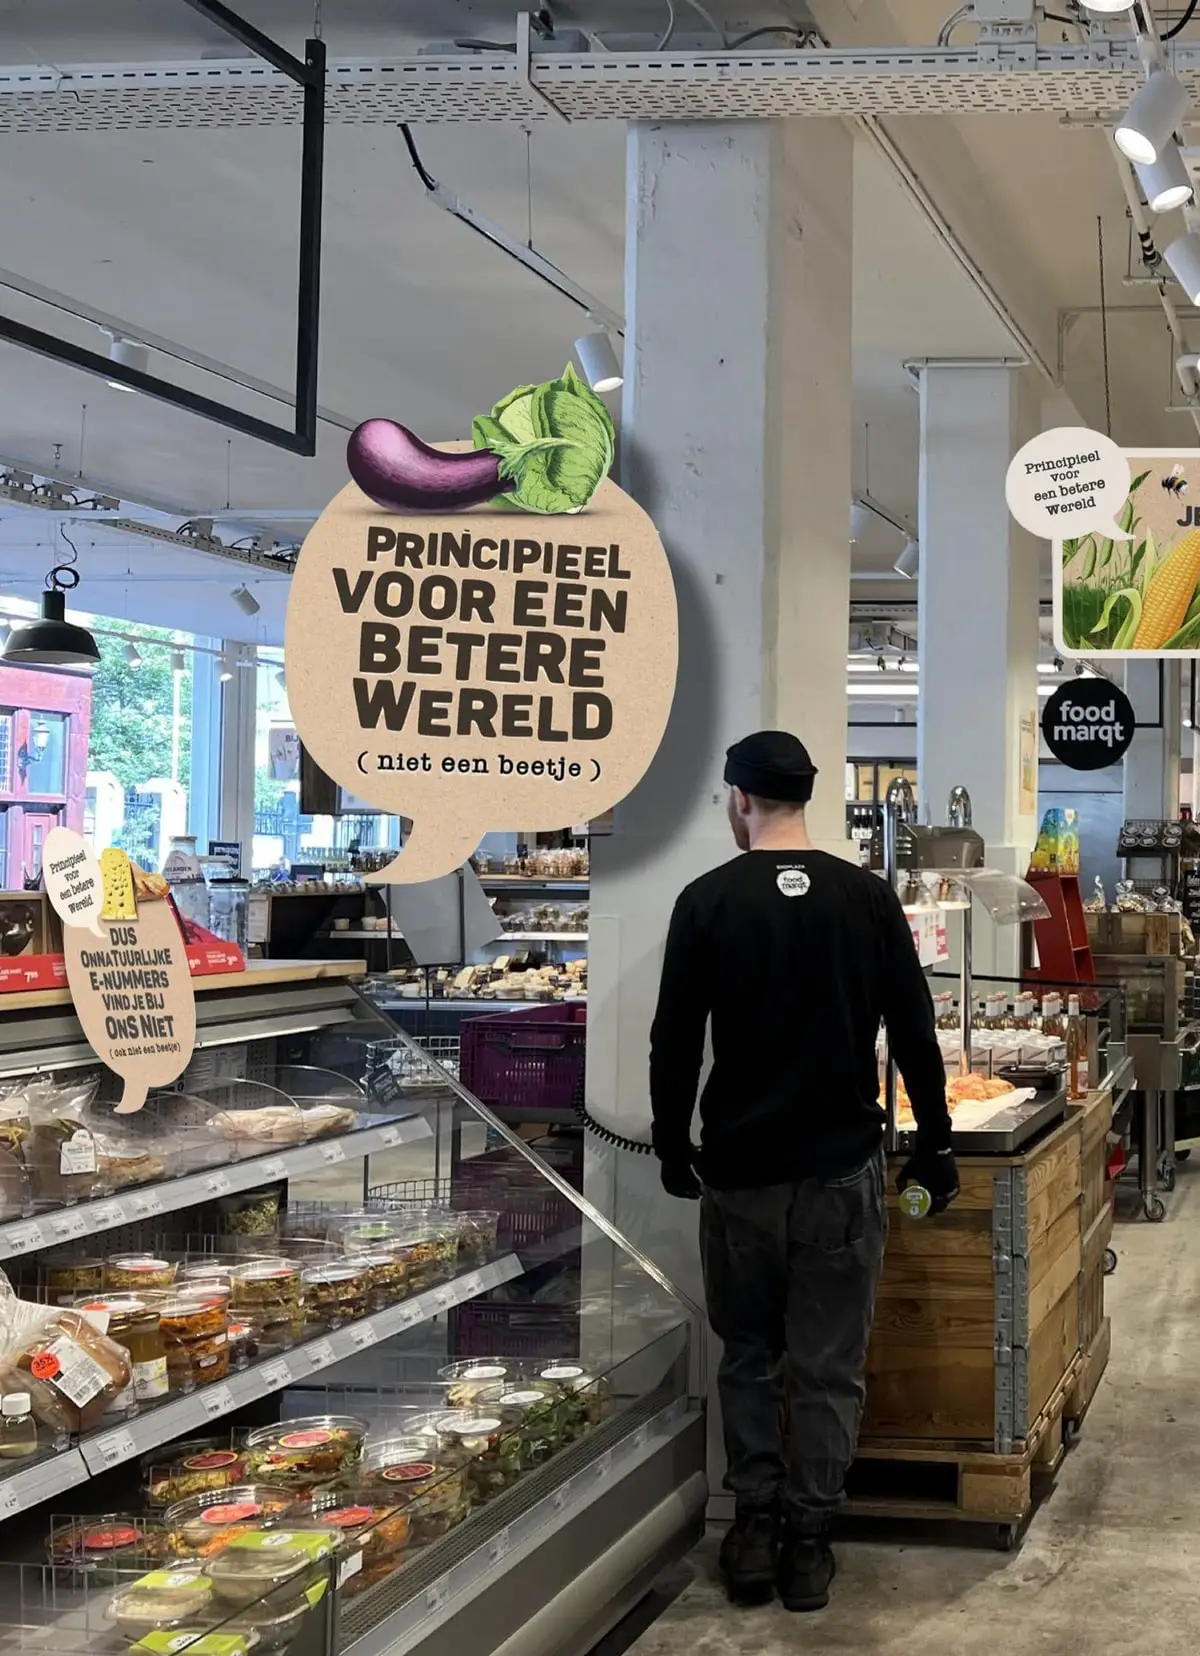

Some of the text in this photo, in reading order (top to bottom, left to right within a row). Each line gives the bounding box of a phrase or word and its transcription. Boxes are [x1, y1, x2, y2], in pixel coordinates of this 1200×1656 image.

[1024, 450, 1101, 475] Principieel
[1050, 470, 1080, 482] voor
[1034, 479, 1106, 501] een betere
[366, 526, 632, 580] PRINCIPIEEL
[332, 567, 628, 634] VOOR EEN
[359, 621, 607, 688] BETERE
[352, 677, 614, 742] WERELD
[1059, 700, 1115, 722] food
[1053, 722, 1125, 747] marqt
[377, 753, 432, 772] niet
[441, 758, 489, 774] een
[498, 756, 582, 781] beetje
[110, 927, 137, 946] DUS
[80, 948, 173, 968] ONNATUURLIJKE
[89, 969, 170, 991] E-NUMMERS
[102, 992, 165, 1011] VIND JE BIJ
[105, 1014, 174, 1040] ONS NIET
